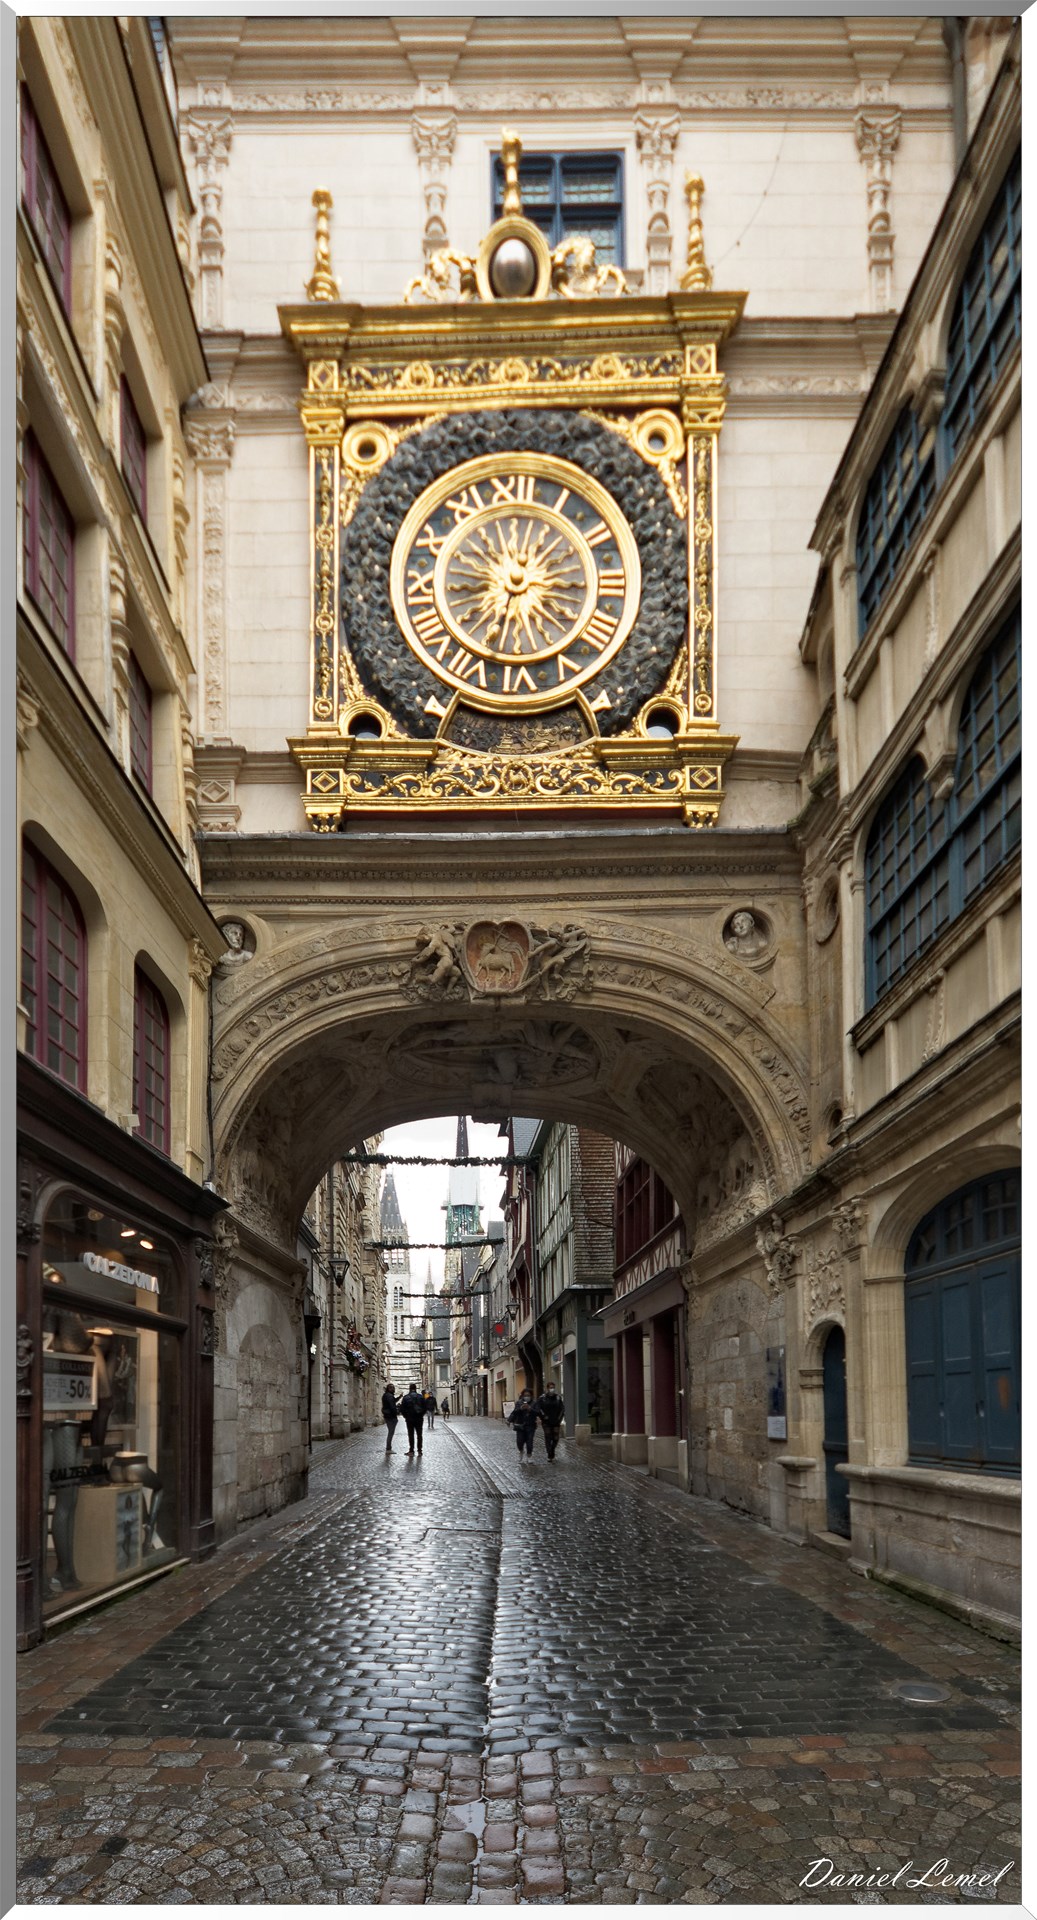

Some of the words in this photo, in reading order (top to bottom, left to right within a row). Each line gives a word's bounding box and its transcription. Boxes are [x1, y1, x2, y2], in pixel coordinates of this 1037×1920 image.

[445, 485, 485, 524] XI
[490, 475, 535, 503] XII
[553, 488, 570, 513] I
[415, 522, 451, 557] X
[583, 520, 611, 547] II
[408, 570, 434, 606] IX
[598, 567, 625, 596] III
[411, 607, 451, 662] VIII
[580, 609, 619, 652] IIII
[447, 647, 488, 688] VII
[502, 665, 538, 693] VI
[557, 653, 582, 682] V
[82, 1252, 160, 1294] CALZEDONIA
[50, 1463, 109, 1482] CALZED
